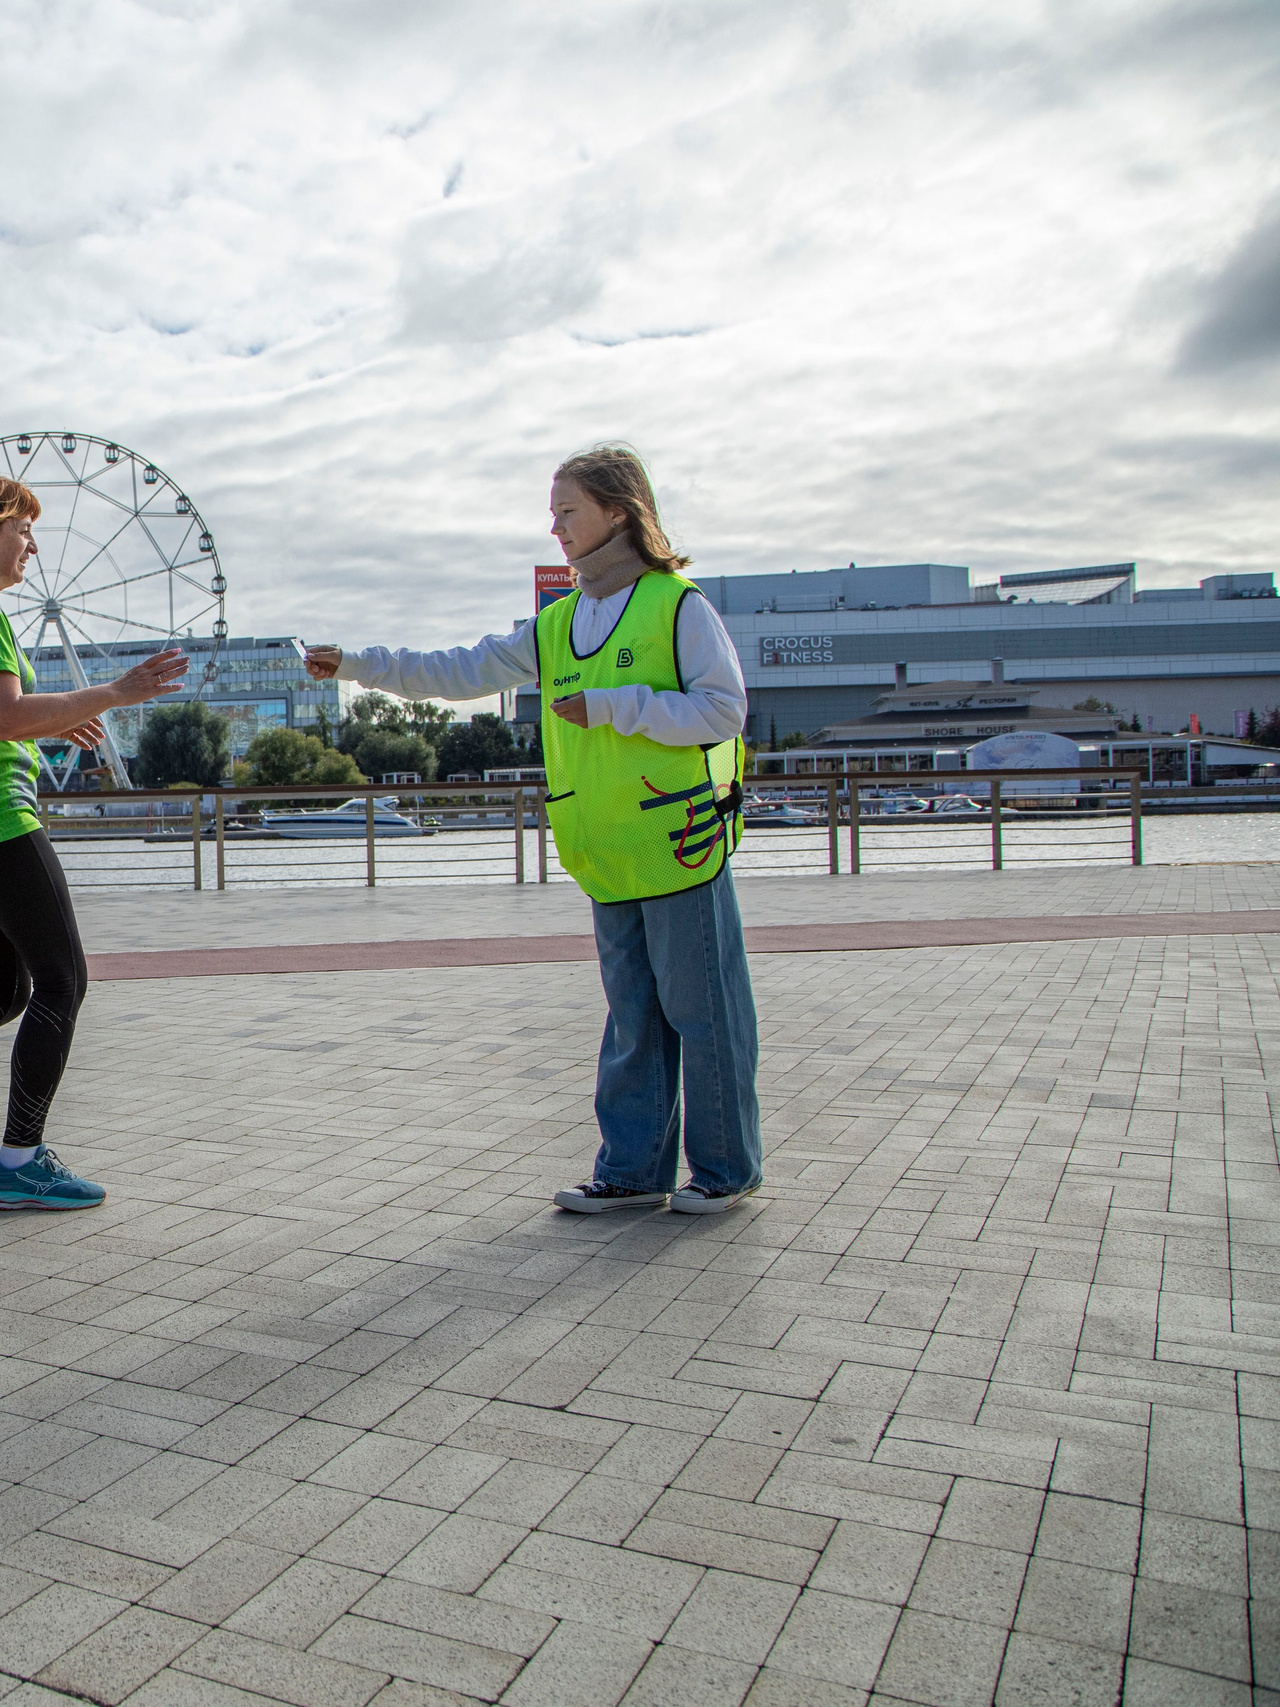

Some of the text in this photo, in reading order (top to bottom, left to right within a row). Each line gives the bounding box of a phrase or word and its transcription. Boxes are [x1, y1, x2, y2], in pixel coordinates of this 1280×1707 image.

[763, 636, 833, 649] CROCUS
[924, 725, 1017, 737] SHORE HOUSE
